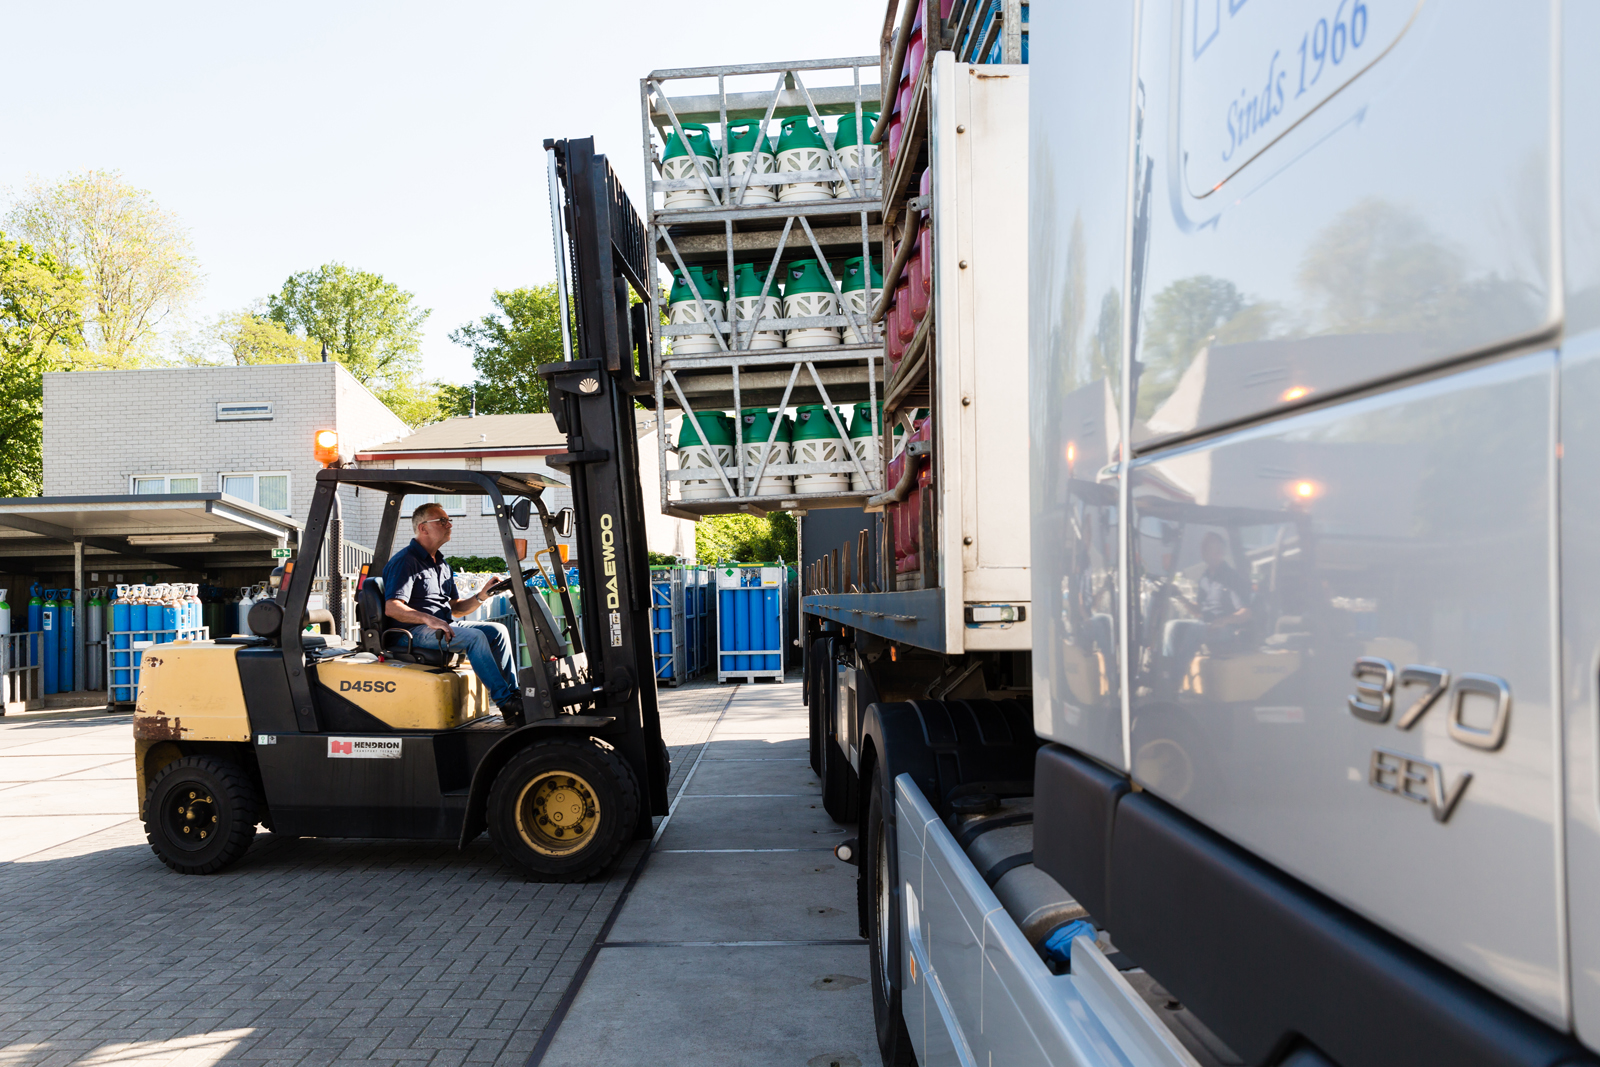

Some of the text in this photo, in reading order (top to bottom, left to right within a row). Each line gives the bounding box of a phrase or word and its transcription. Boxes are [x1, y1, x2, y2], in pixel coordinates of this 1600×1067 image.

[1222, 50, 1286, 162] Sinds
[1294, 0, 1368, 99] 1966
[600, 513, 619, 609] DAEWOO
[340, 680, 396, 693] D45SC
[1348, 656, 1511, 751] 370
[1370, 747, 1474, 823] EEV
